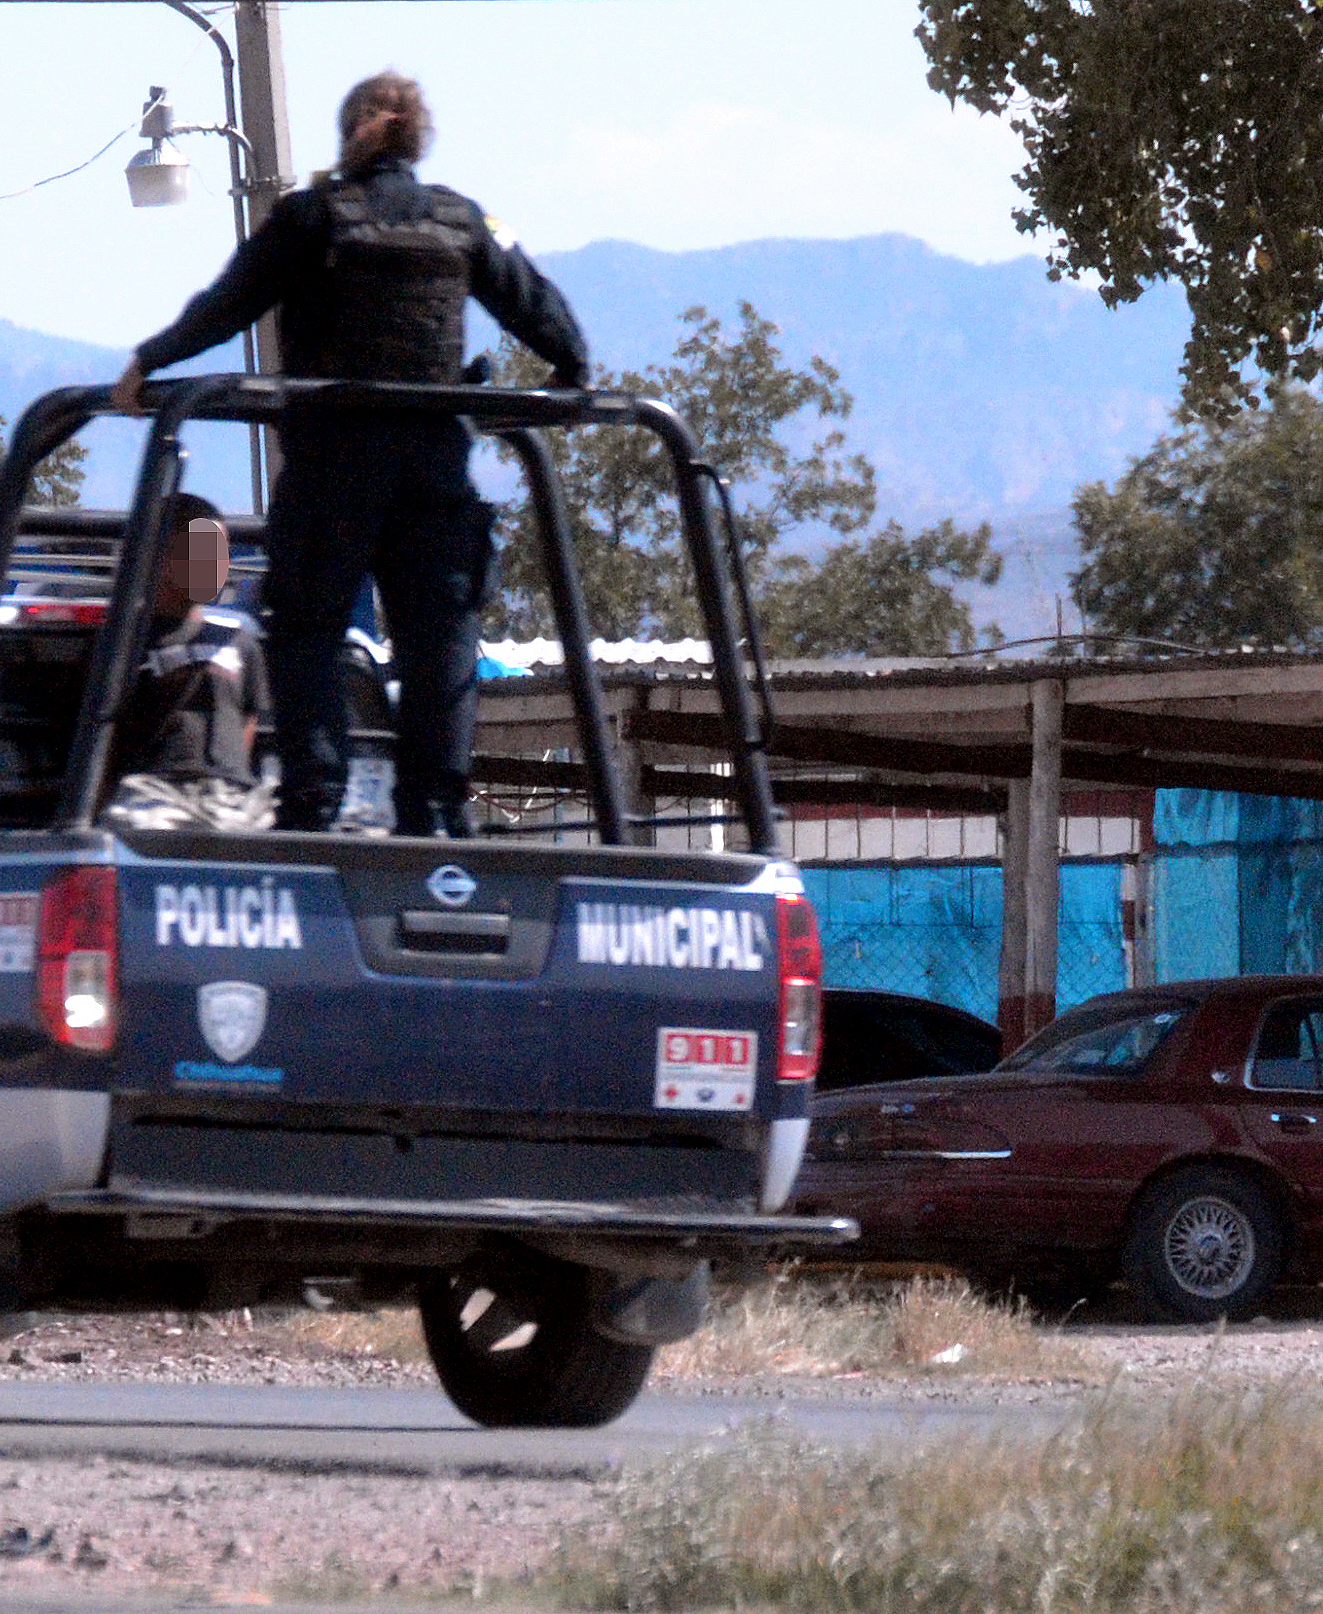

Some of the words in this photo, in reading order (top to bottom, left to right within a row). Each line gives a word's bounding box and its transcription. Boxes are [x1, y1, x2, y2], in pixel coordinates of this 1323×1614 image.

[155, 875, 302, 950] POLICÍA
[577, 902, 765, 972] MUNICIPAL
[669, 1035, 746, 1064] 911
